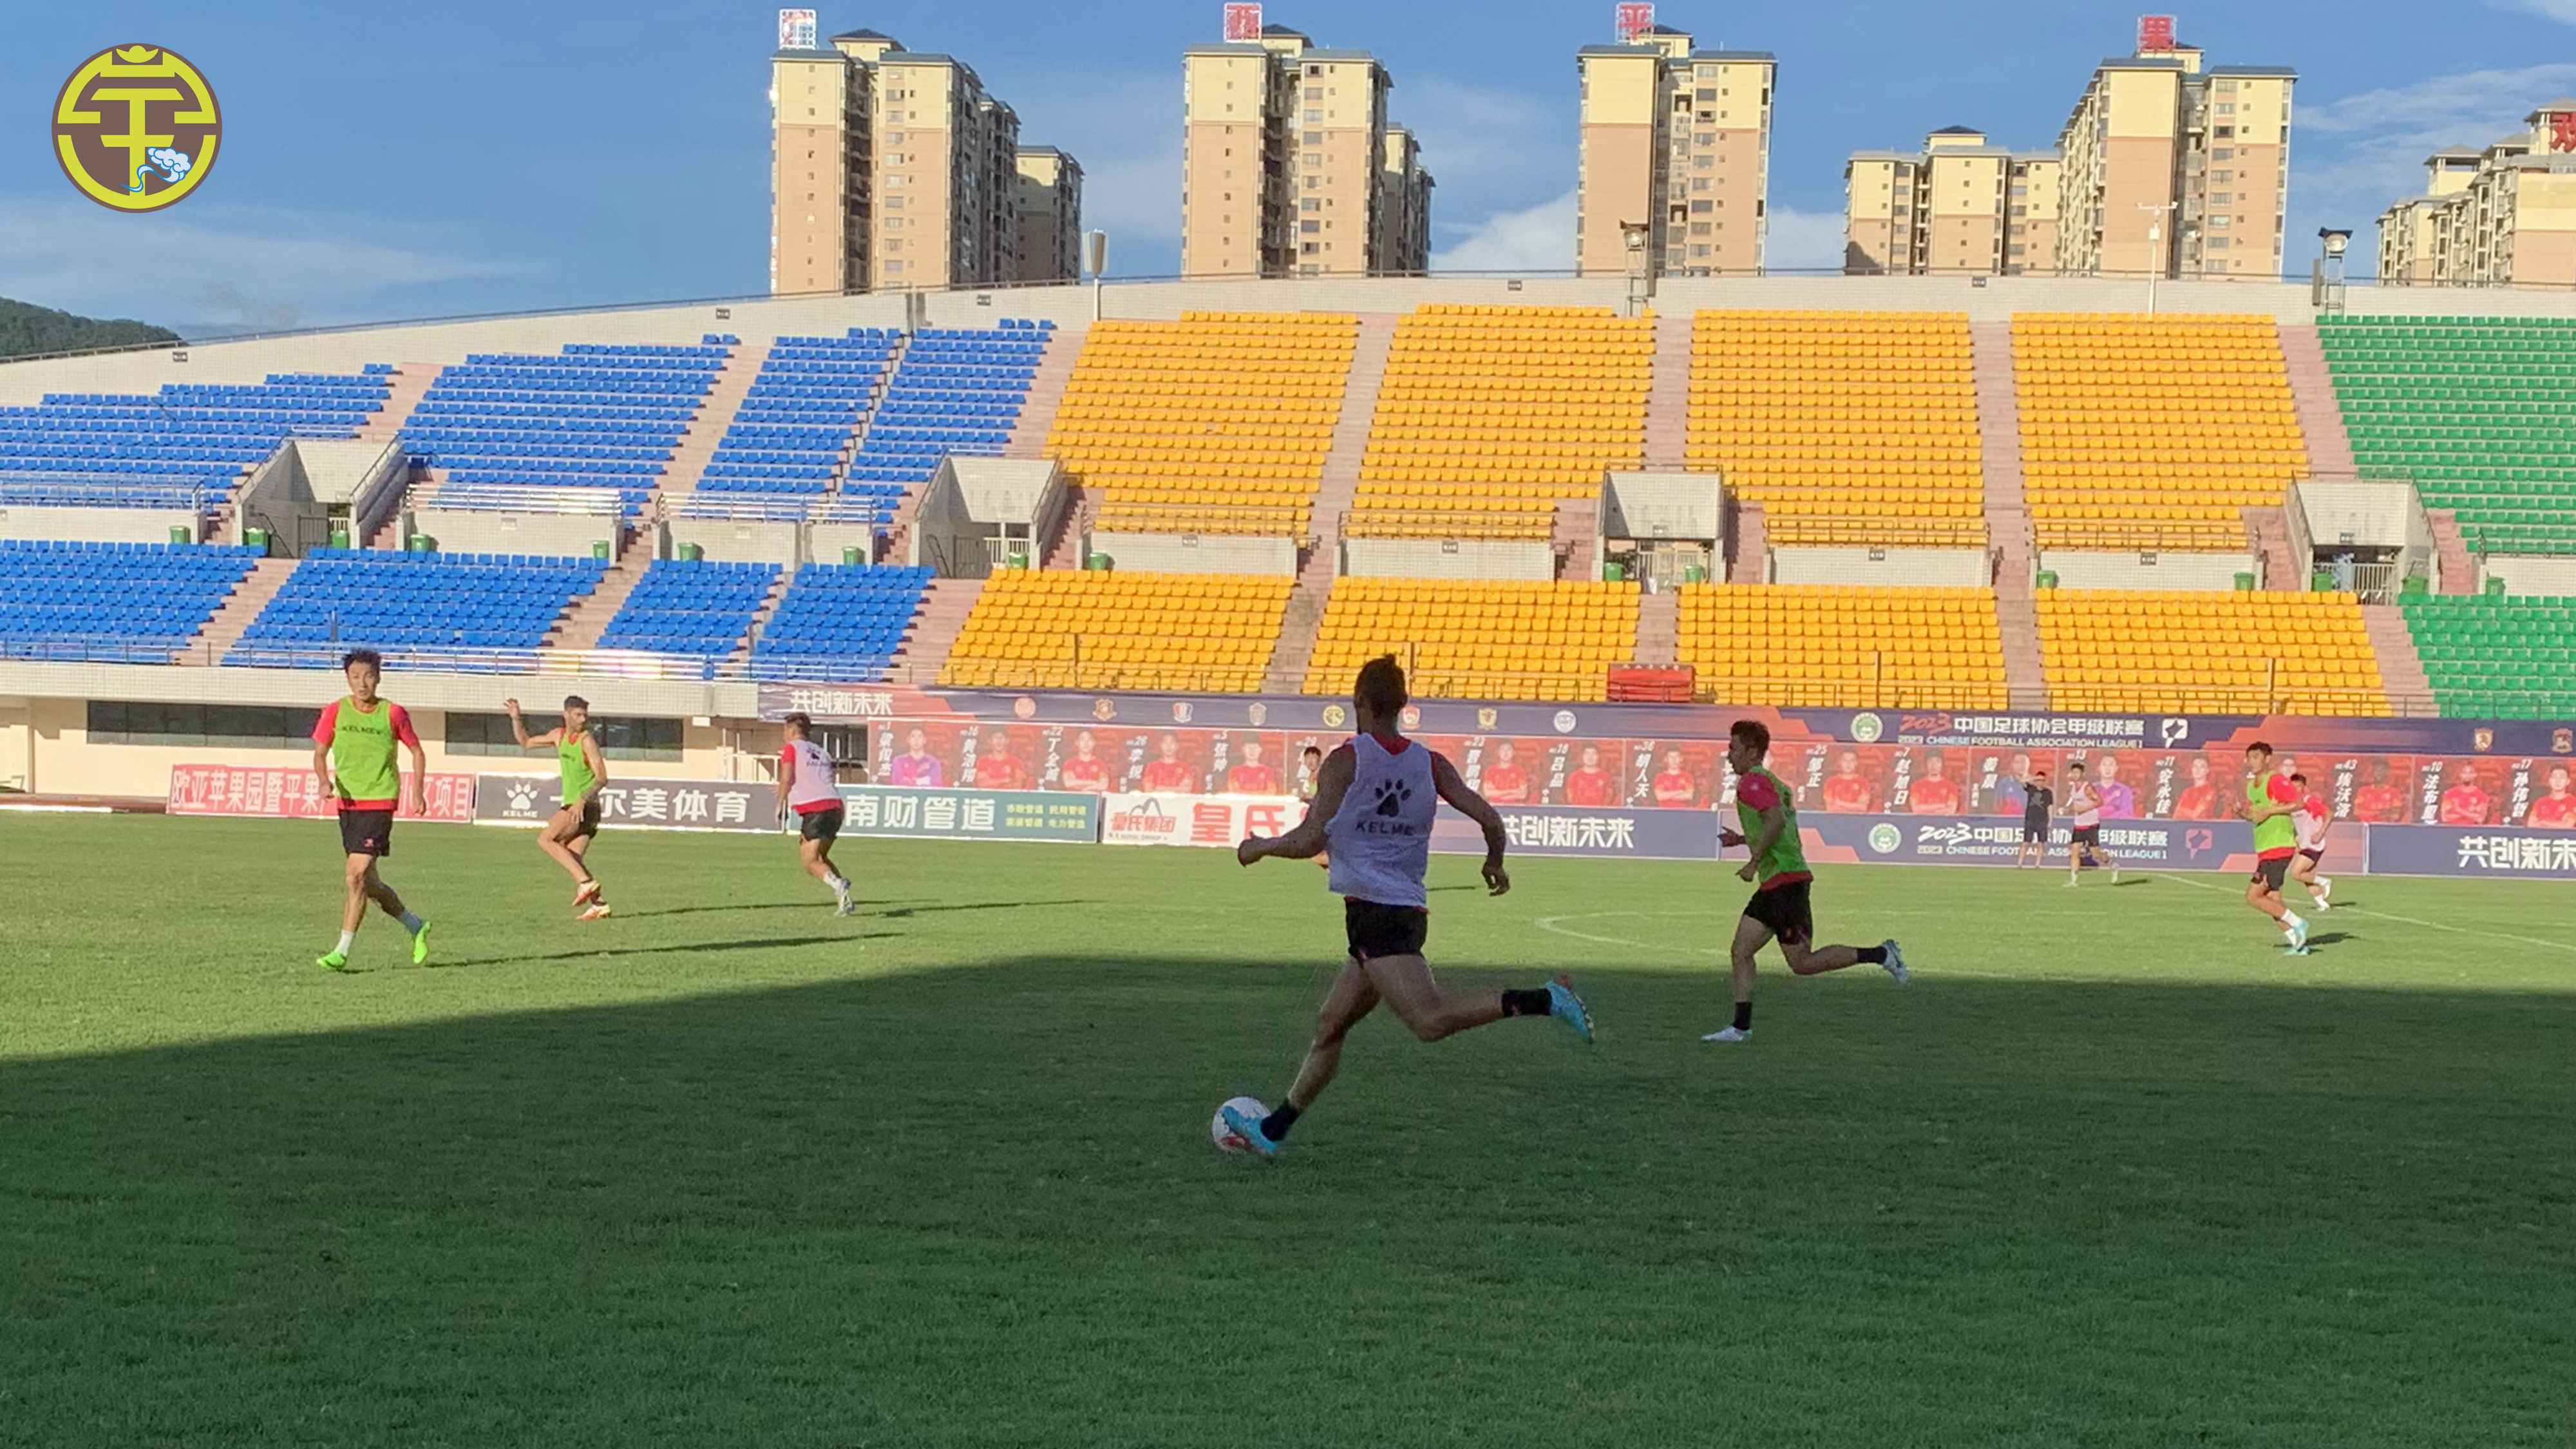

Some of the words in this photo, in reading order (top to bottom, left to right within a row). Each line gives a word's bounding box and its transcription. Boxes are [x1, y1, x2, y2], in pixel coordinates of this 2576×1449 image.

[1618, 4, 1654, 41] 平
[790, 690, 894, 715] 共创新未来
[1971, 737, 2024, 746] FOOTBALL
[2027, 738, 2095, 748] ASSOCIATION
[2097, 740, 2136, 748] LEAGUE
[549, 786, 751, 823] 尔美体育
[845, 794, 996, 831] 南财管道
[1189, 802, 1308, 842] 皇氏
[1354, 821, 1414, 837] KELME
[1502, 814, 1635, 849] 共创新未来
[2119, 849, 2161, 859] LEAGUE
